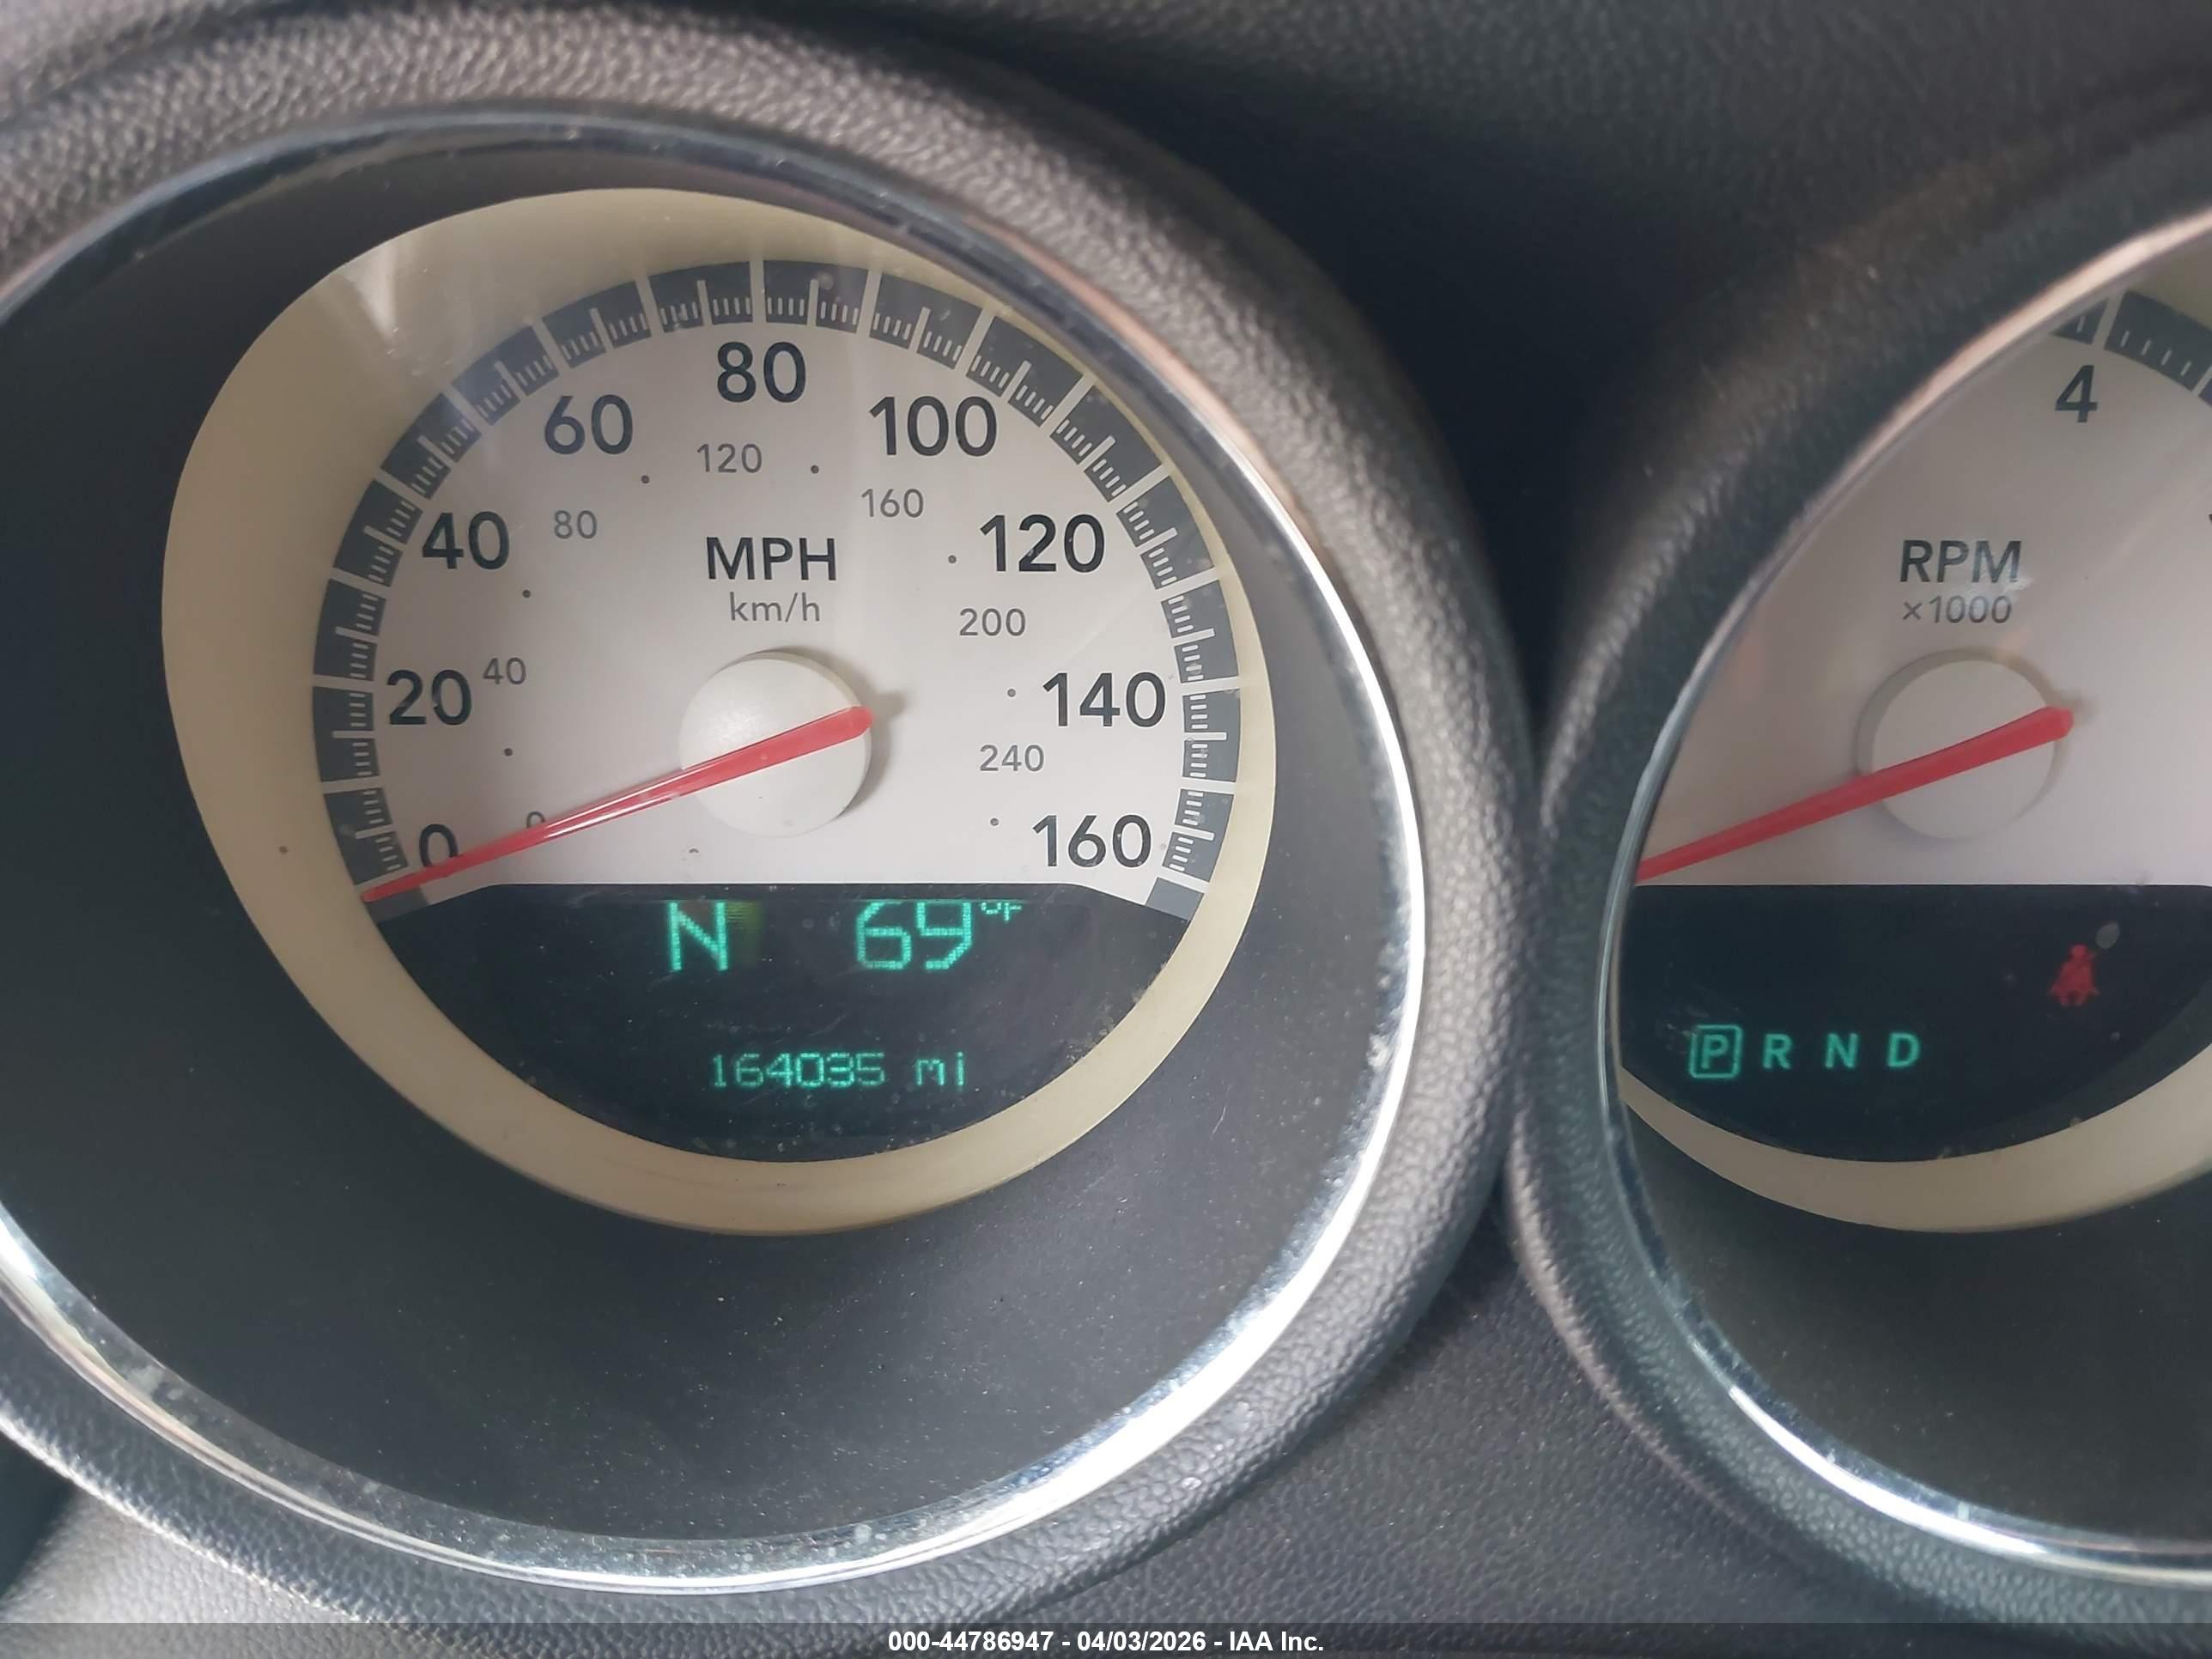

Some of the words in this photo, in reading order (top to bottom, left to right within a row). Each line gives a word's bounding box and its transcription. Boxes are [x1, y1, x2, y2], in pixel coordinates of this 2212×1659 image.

[716, 341, 807, 404] 80
[2054, 364, 2098, 423] 4
[544, 393, 634, 455] 60
[869, 395, 999, 457] 100
[696, 442, 763, 474] 120
[553, 509, 599, 539] 80
[860, 489, 925, 519] 160
[422, 510, 510, 570] 40
[705, 536, 838, 581] MPH
[980, 513, 1106, 574] 120
[1899, 539, 2023, 584] RPM
[730, 592, 821, 623] km/h
[958, 607, 1027, 638] 200
[482, 657, 527, 686] 40
[386, 669, 473, 726] 20
[1042, 672, 1166, 728] 140
[979, 744, 1046, 773] 240
[1032, 814, 1152, 869] 160
[665, 900, 730, 972] N
[855, 900, 975, 970] 69
[712, 1052, 886, 1090] 164035
[915, 1051, 967, 1089] mi
[1700, 1033, 1729, 1069] P
[1761, 1032, 1793, 1070] R
[1824, 1032, 1859, 1068] N
[1887, 1032, 1921, 1068] D
